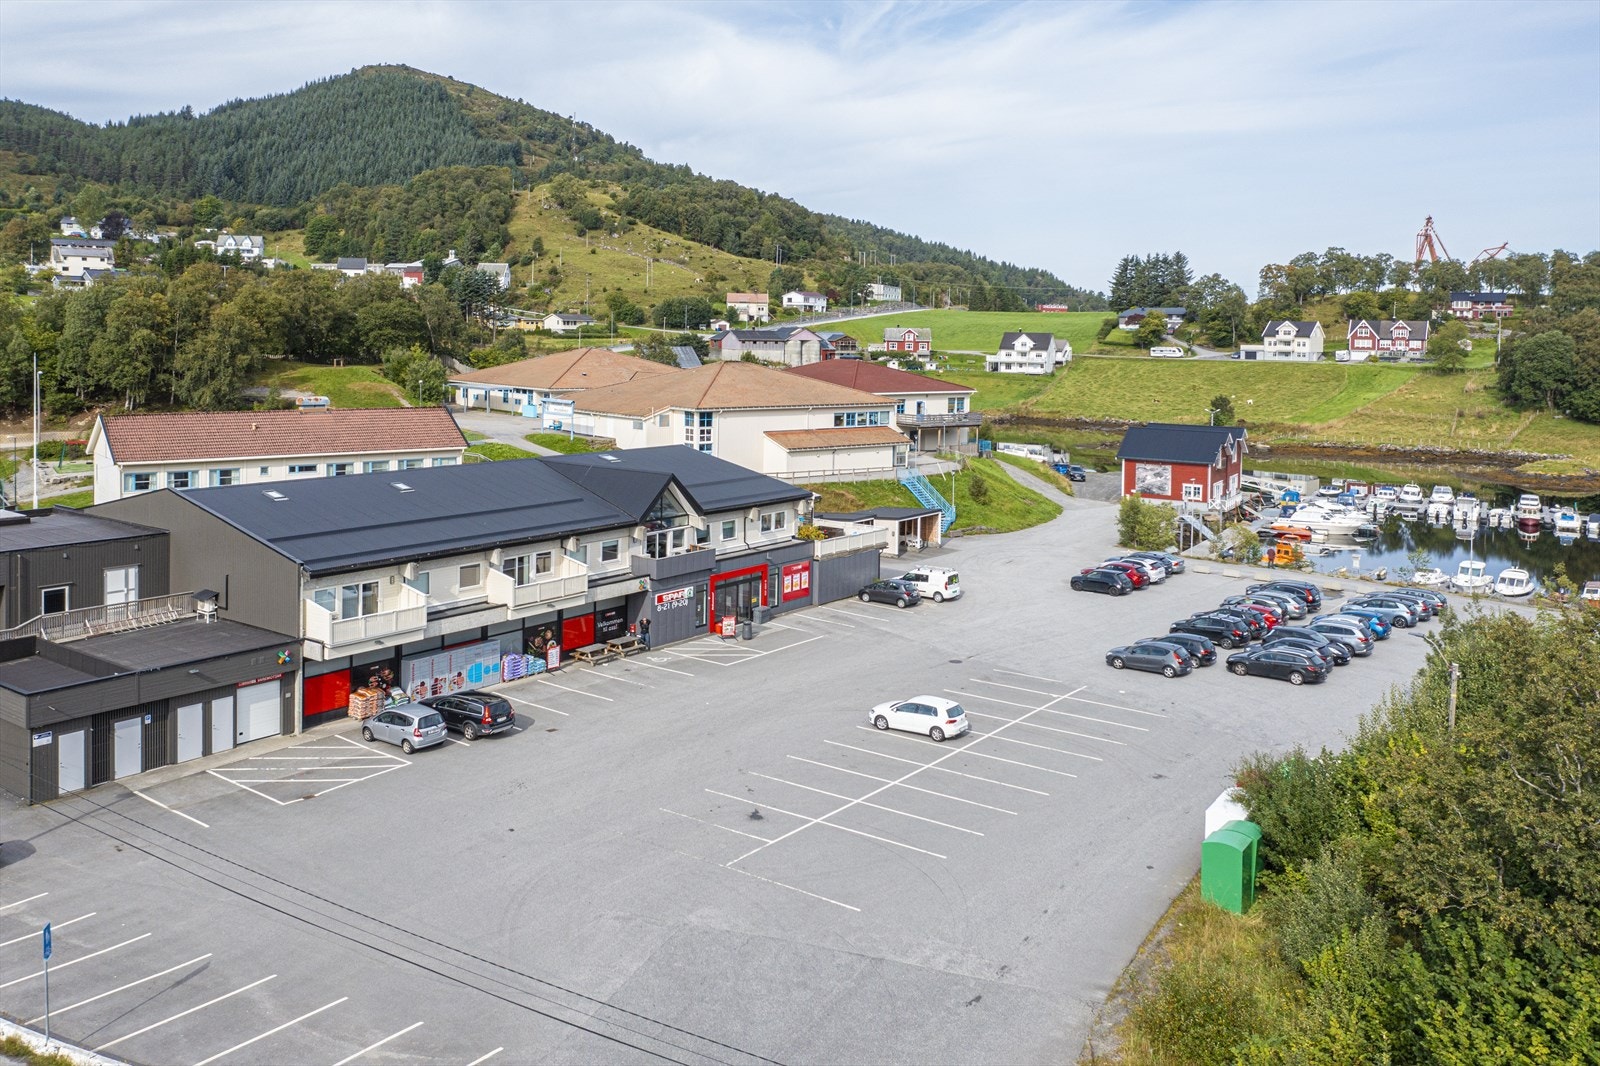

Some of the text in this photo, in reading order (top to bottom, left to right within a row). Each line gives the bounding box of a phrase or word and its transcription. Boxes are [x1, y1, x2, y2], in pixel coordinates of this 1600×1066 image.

[662, 592, 685, 602] SPAR
[657, 602, 670, 612] 8-21
[597, 618, 623, 628] Velkommen
